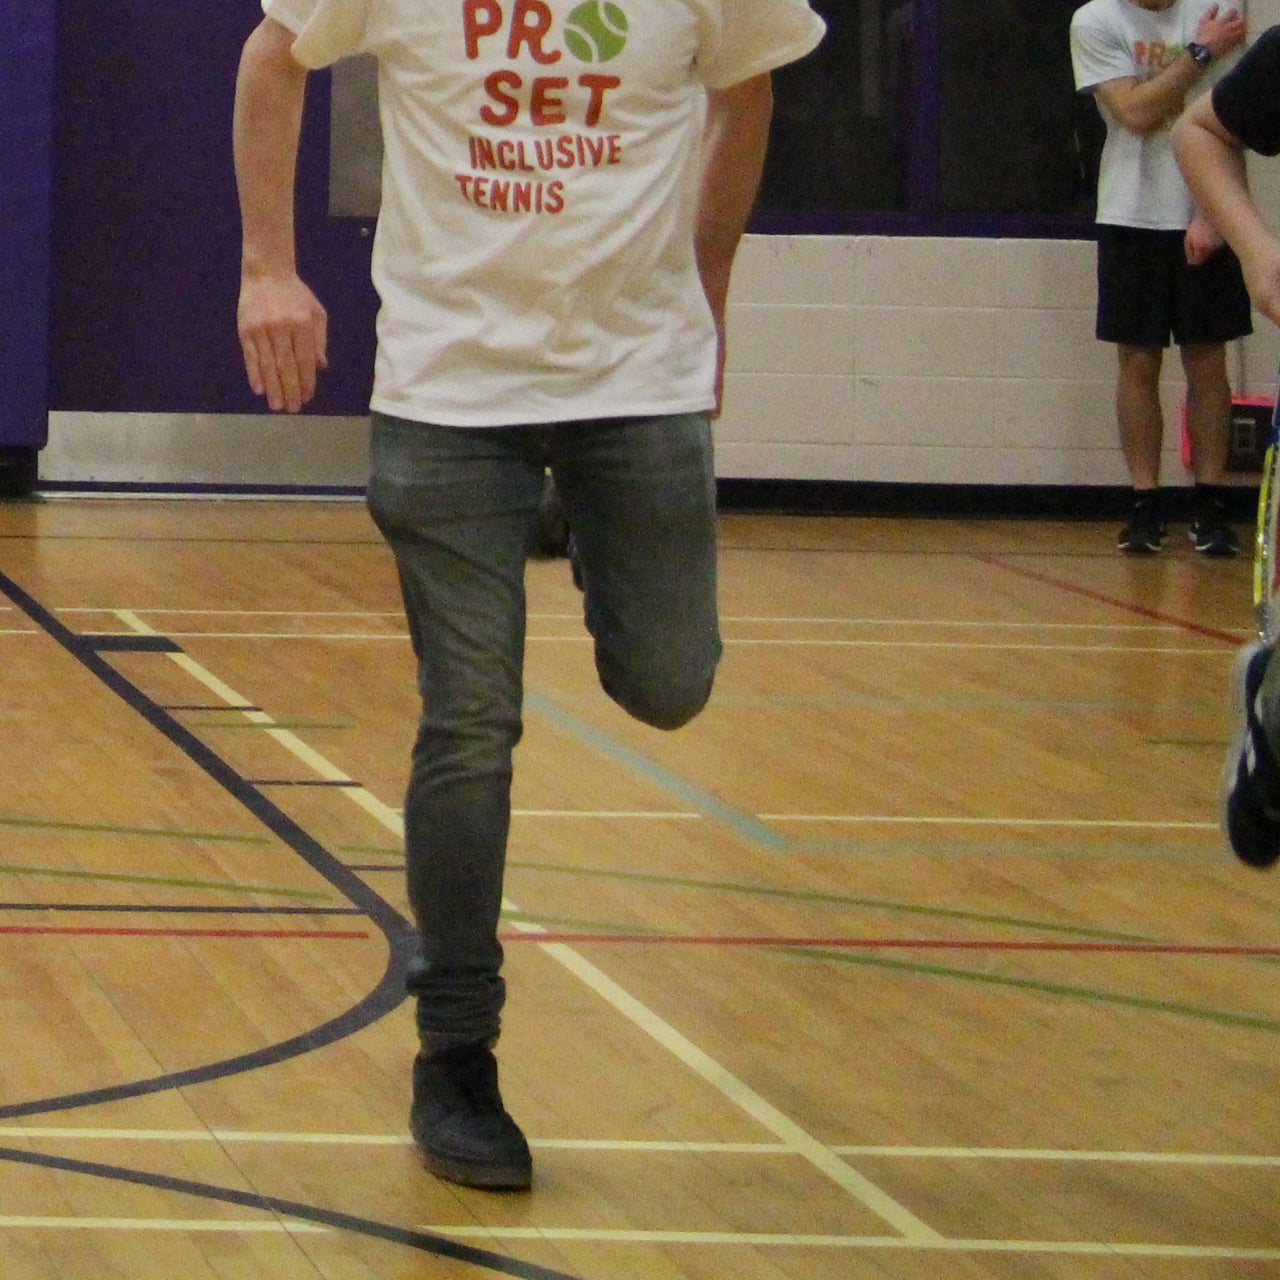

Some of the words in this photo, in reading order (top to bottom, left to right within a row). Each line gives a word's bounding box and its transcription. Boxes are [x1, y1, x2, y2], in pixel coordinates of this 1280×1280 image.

[480, 70, 621, 127] SET
[469, 134, 622, 171] INCLUSIVE
[455, 174, 565, 214] TENNIS
